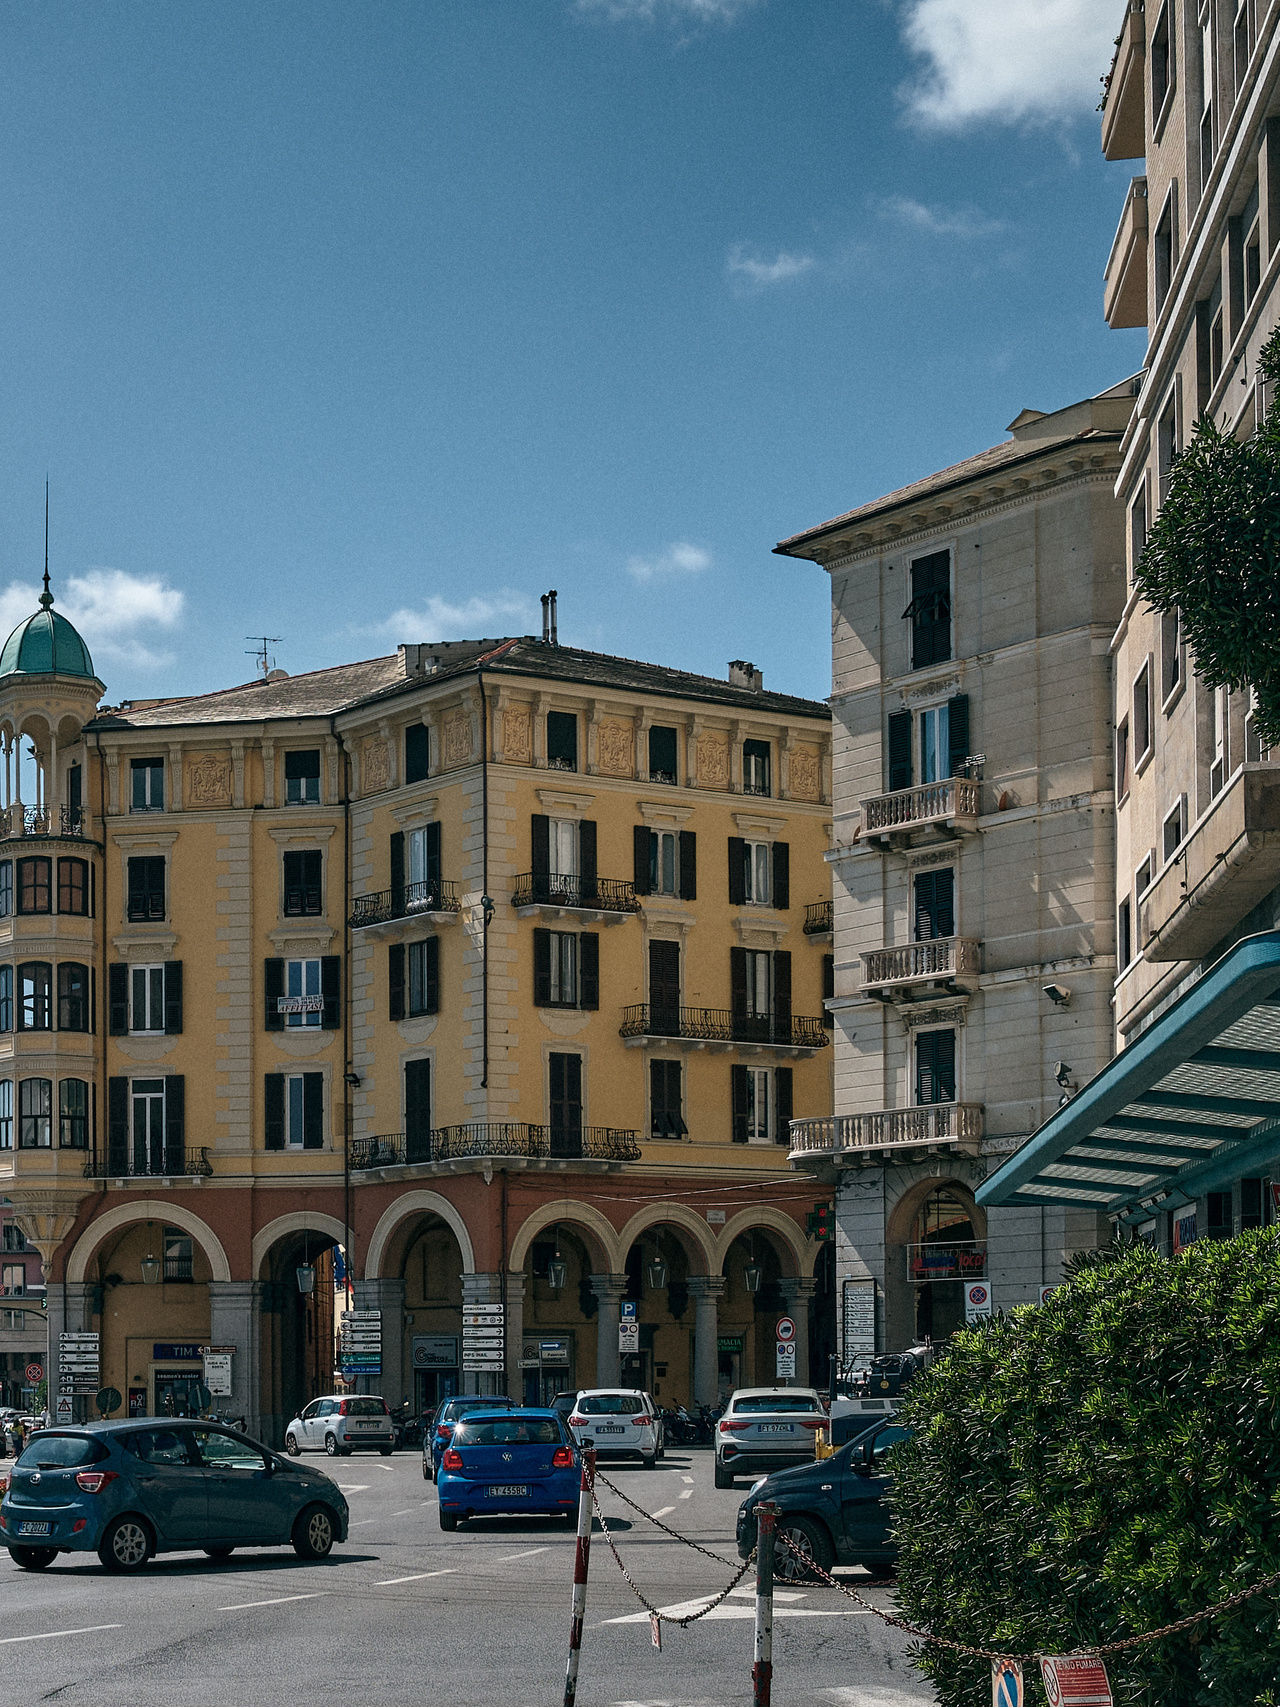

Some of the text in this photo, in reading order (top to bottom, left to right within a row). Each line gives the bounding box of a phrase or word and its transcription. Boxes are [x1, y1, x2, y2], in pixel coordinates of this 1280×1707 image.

[279, 1002, 322, 1012] AFFITTASI
[959, 1251, 987, 1267] local
[624, 1303, 633, 1315] P
[173, 1347, 193, 1356] TIM
[1076, 1658, 1102, 1670] FUMARE
